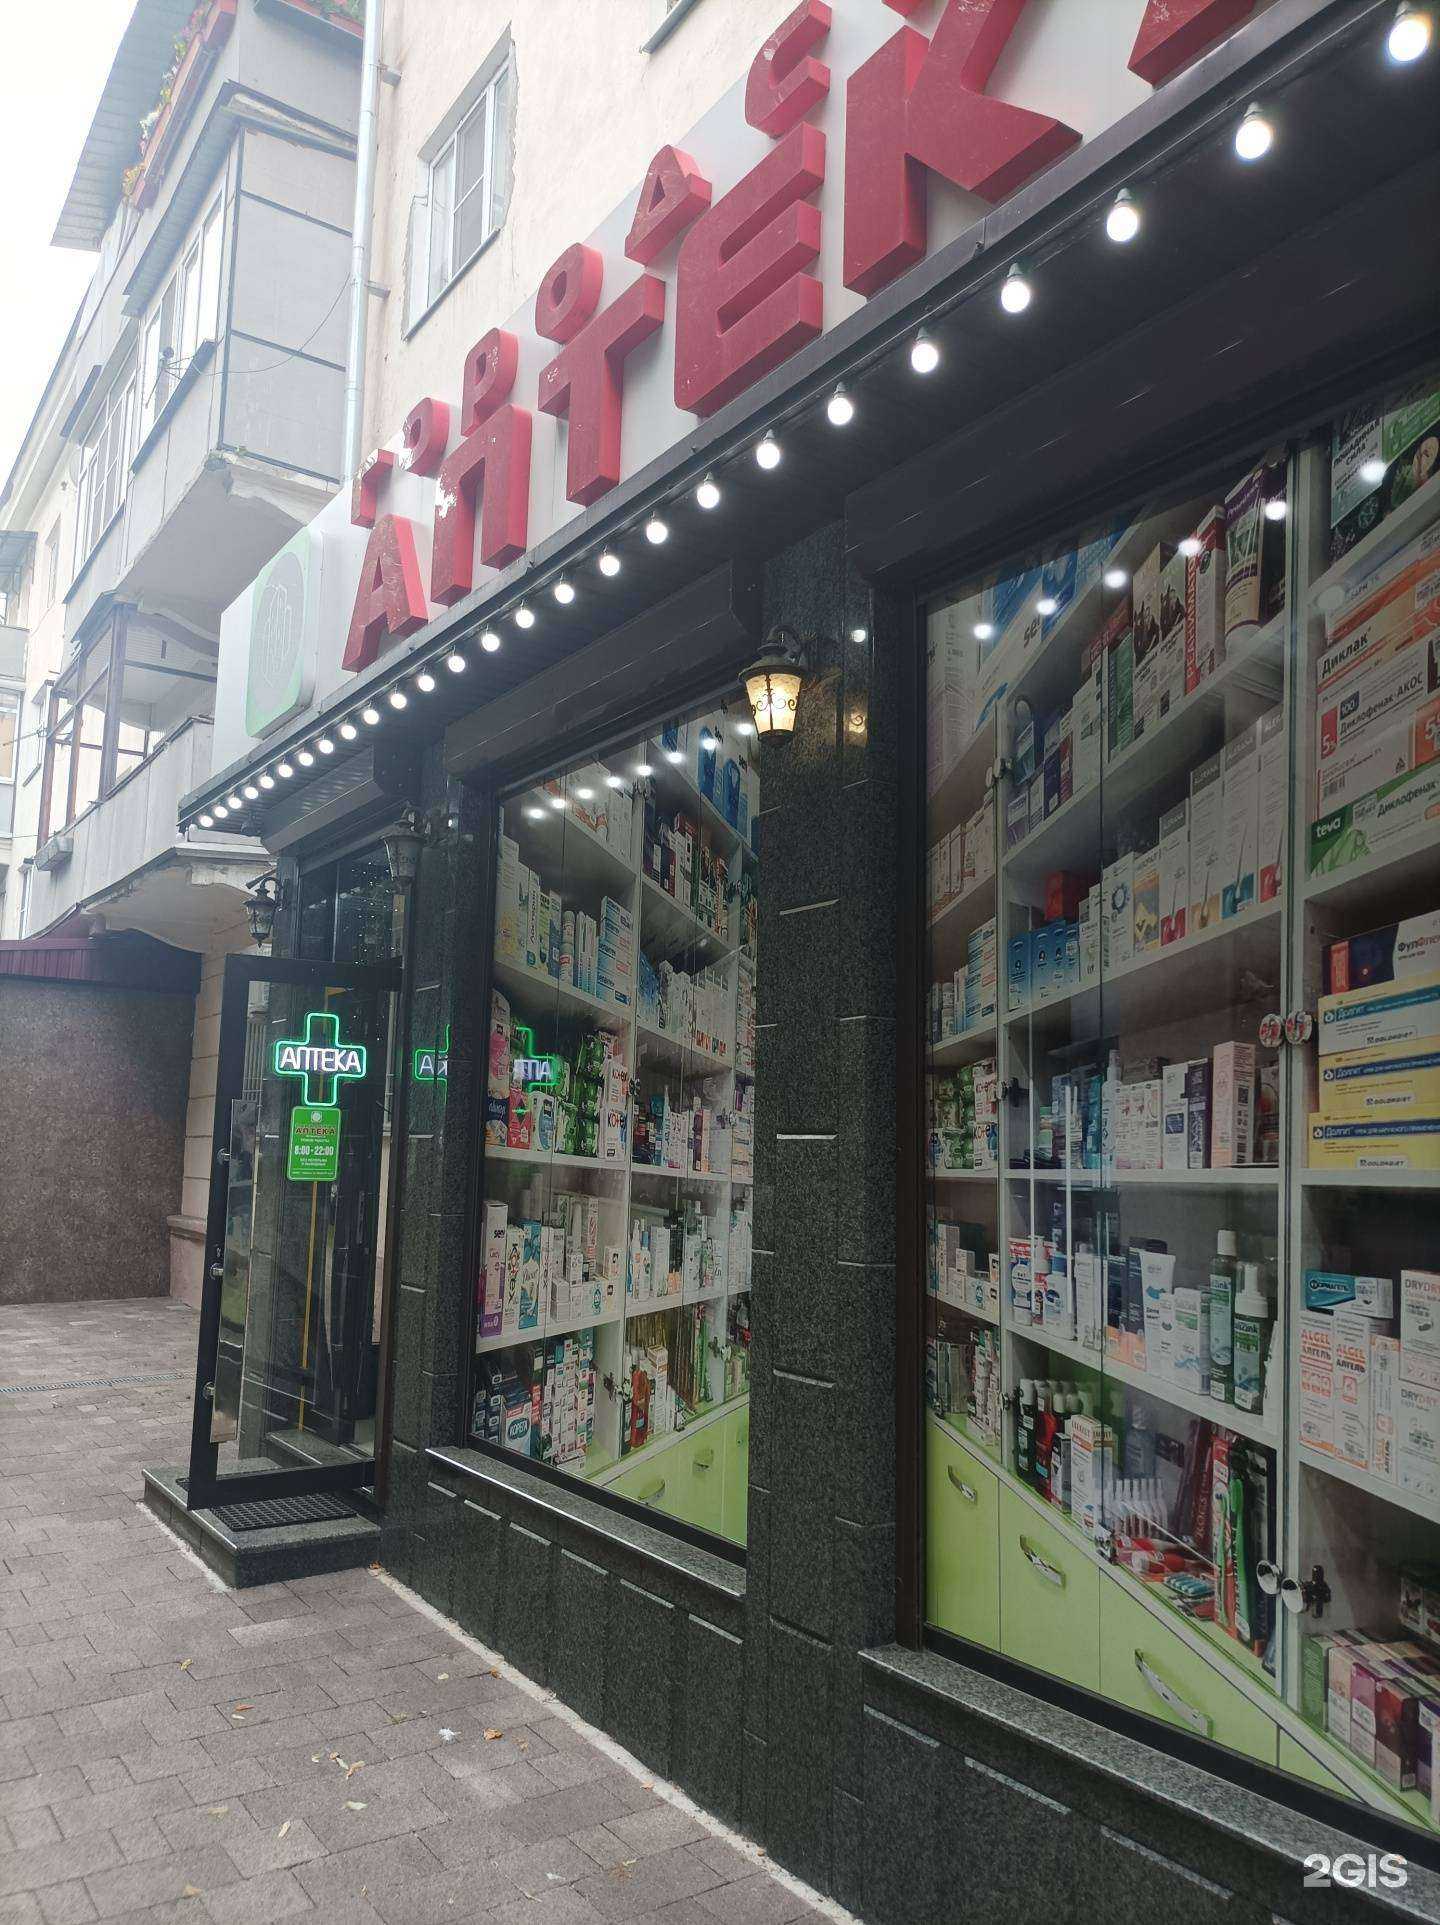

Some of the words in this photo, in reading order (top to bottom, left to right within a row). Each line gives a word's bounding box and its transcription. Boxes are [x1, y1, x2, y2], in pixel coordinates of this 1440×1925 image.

[1316, 816, 1342, 838] teva
[279, 1046, 361, 1074] АПТЕКА
[295, 1127, 337, 1136] АПТЕКА
